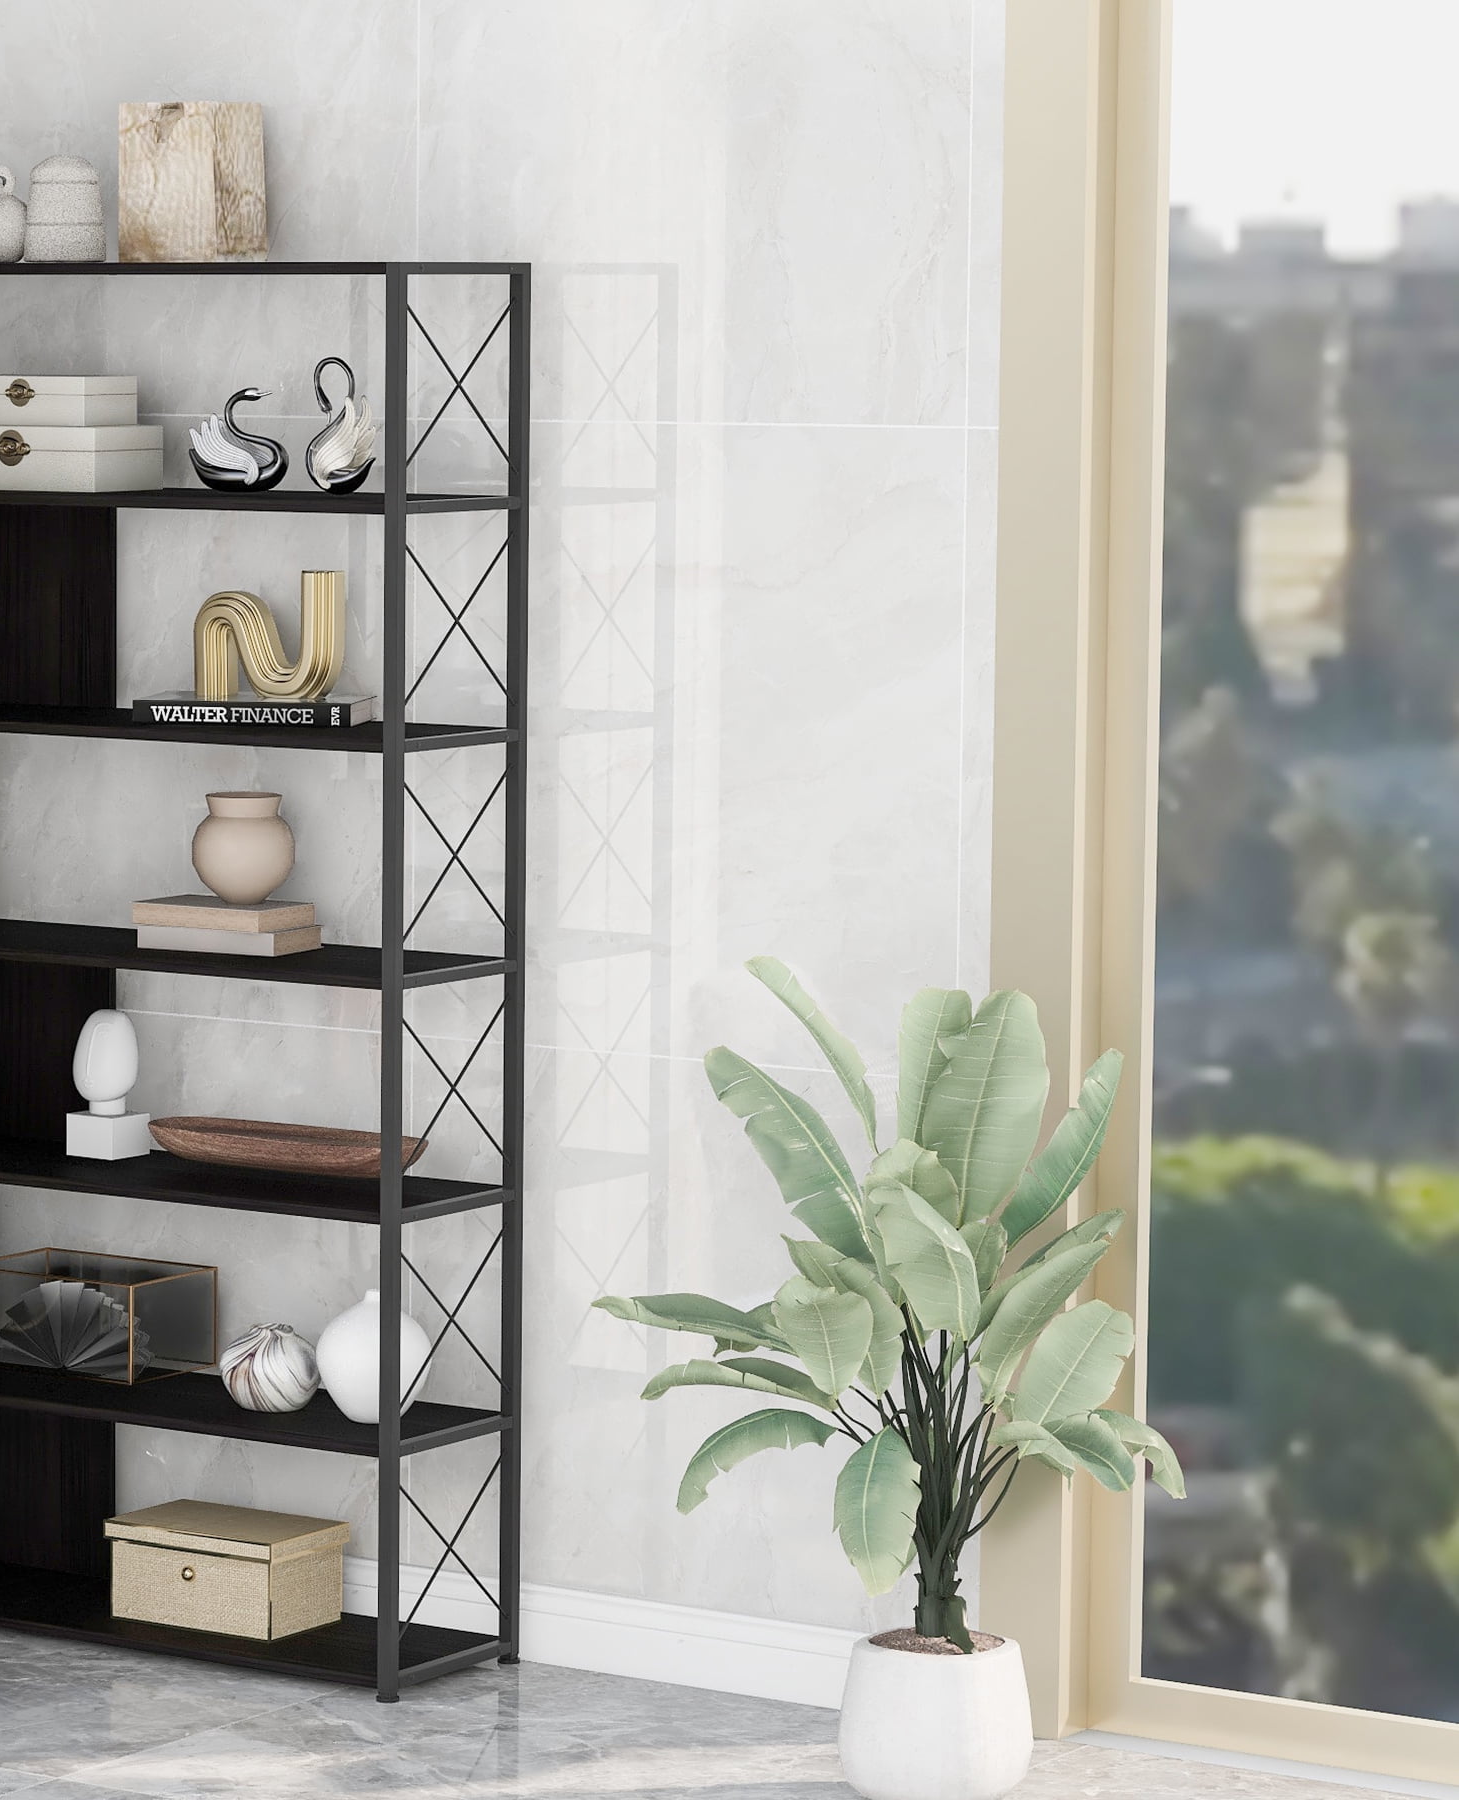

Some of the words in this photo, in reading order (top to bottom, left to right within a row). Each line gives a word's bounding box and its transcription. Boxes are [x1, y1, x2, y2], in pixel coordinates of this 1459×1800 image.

[150, 706, 228, 723] WALTER
[230, 707, 314, 724] FINANCE
[330, 706, 341, 727] EVR
